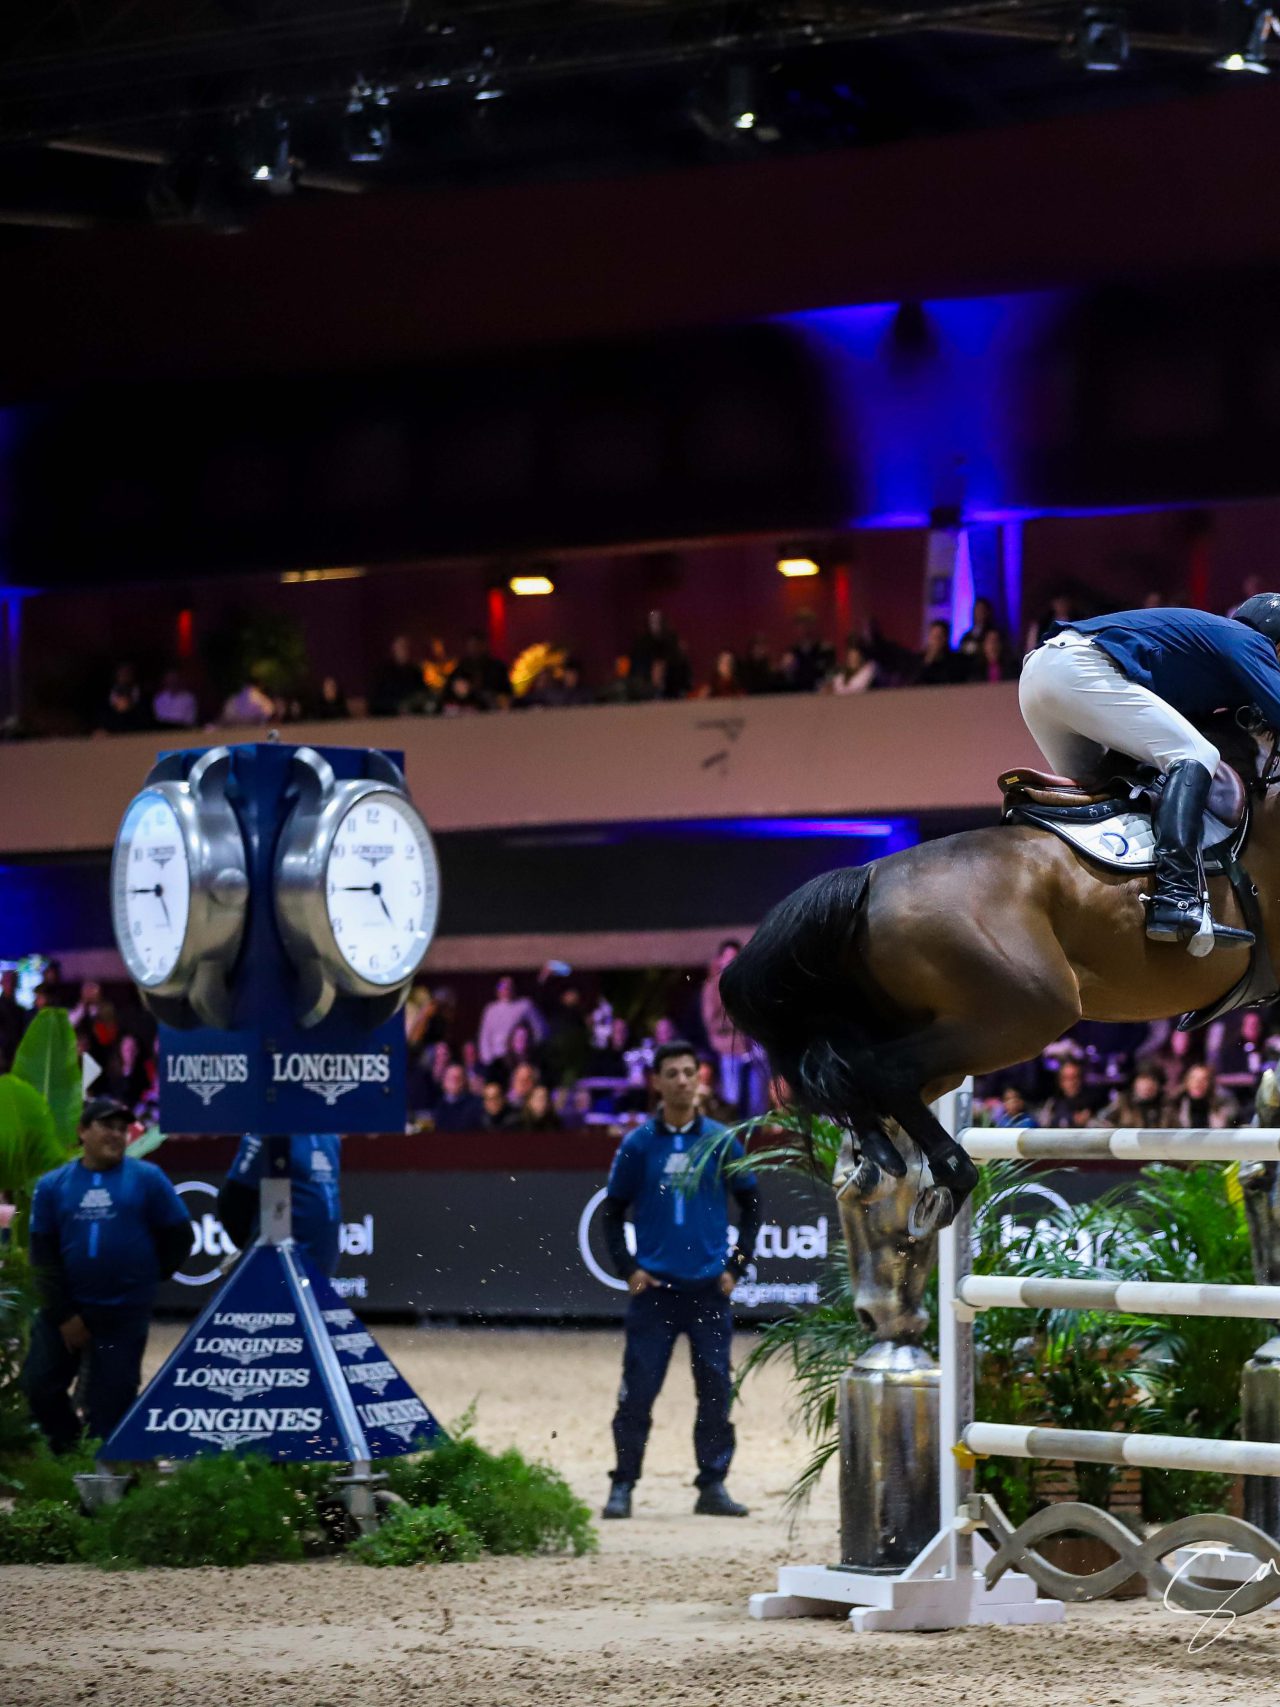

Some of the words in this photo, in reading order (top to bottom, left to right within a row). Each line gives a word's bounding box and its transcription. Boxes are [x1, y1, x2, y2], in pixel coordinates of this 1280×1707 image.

[167, 1054, 249, 1083] LONGINES
[272, 1053, 391, 1082] LONGINES
[213, 1312, 297, 1326] LONGINES
[194, 1337, 304, 1353] LONGINES
[173, 1368, 311, 1387] LONGINES
[145, 1408, 323, 1432] LONGINES
[356, 1398, 429, 1428] LONGINES
